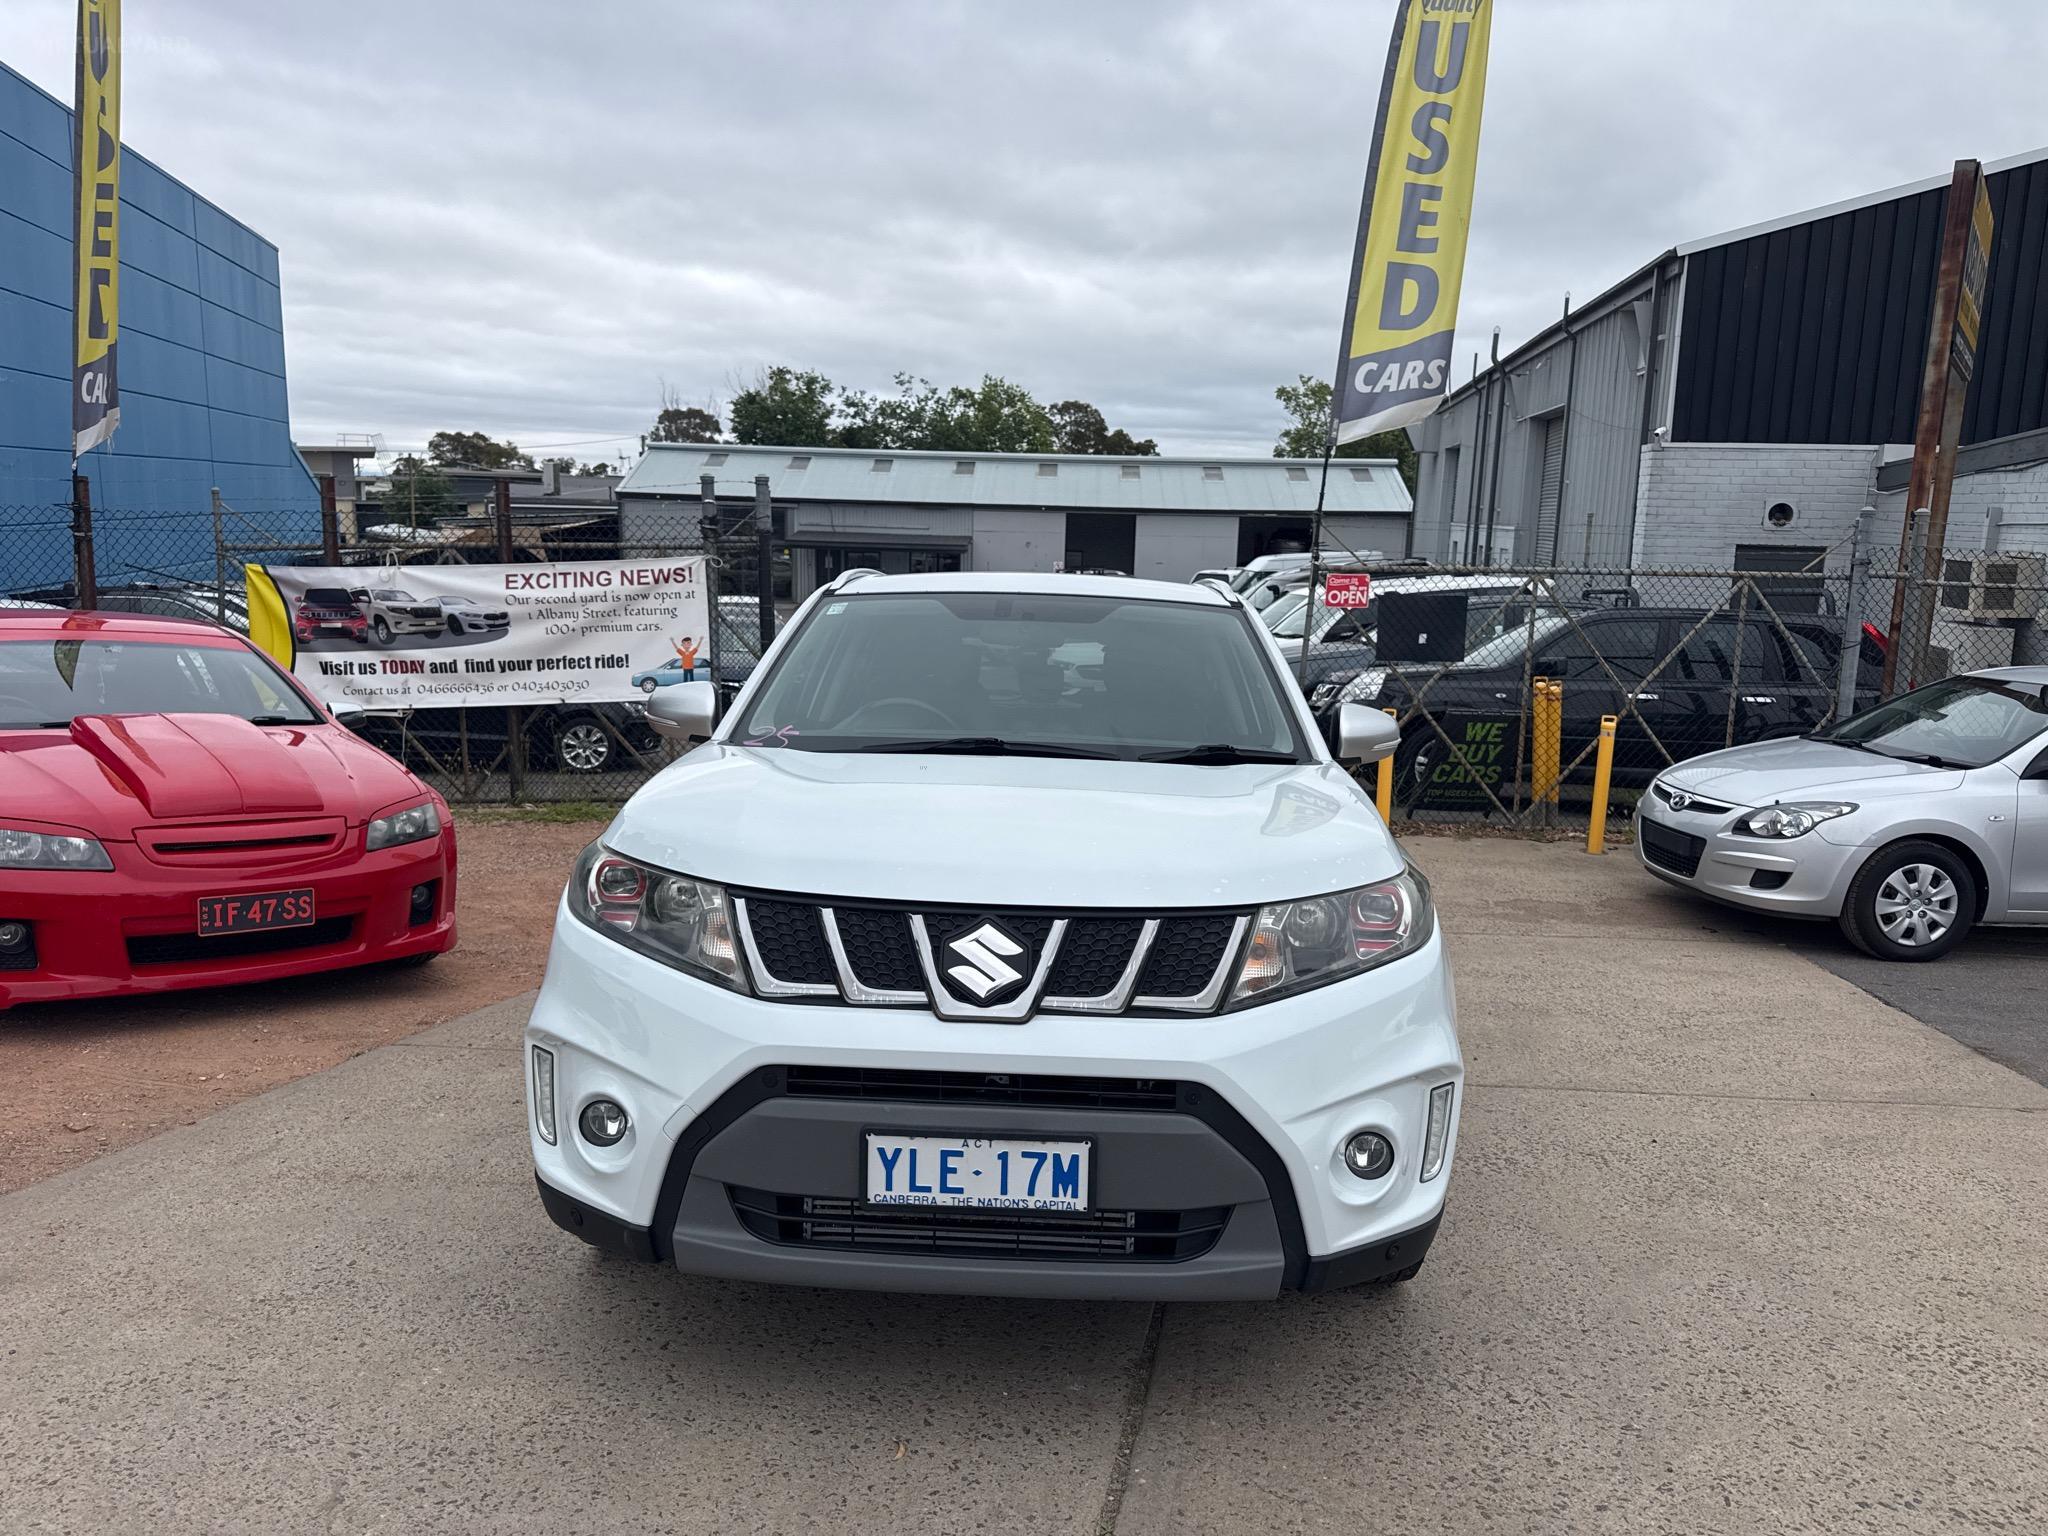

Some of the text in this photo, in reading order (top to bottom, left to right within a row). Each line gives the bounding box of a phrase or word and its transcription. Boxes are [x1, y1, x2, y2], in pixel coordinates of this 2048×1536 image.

[1379, 20, 1472, 331] USED
[1354, 358, 1447, 394] CARS
[505, 567, 694, 590] EXCITING NEWS!
[505, 590, 696, 607] Our second yard is now open at
[1327, 590, 1368, 604] OPEN
[533, 608, 579, 622] Albany
[624, 604, 679, 620] featuring
[581, 623, 633, 637] premium
[636, 622, 664, 632] cars.
[318, 653, 630, 676] Visit us TODAY and find your perfect ride!
[342, 686, 383, 696] Contact
[387, 686, 399, 695] us
[402, 685, 411, 695] at
[497, 684, 509, 693] or
[512, 679, 590, 693] 0403403030
[1466, 722, 1507, 742] WE
[1447, 743, 1505, 763] BUY
[1432, 764, 1502, 784] CARS
[961, 1138, 993, 1149] ACT
[873, 1193, 938, 1206] CANBERRA
[951, 1197, 973, 1208] THE
[978, 1197, 1029, 1209] NATION'S
[1034, 1199, 1080, 1211] CAPITAL
